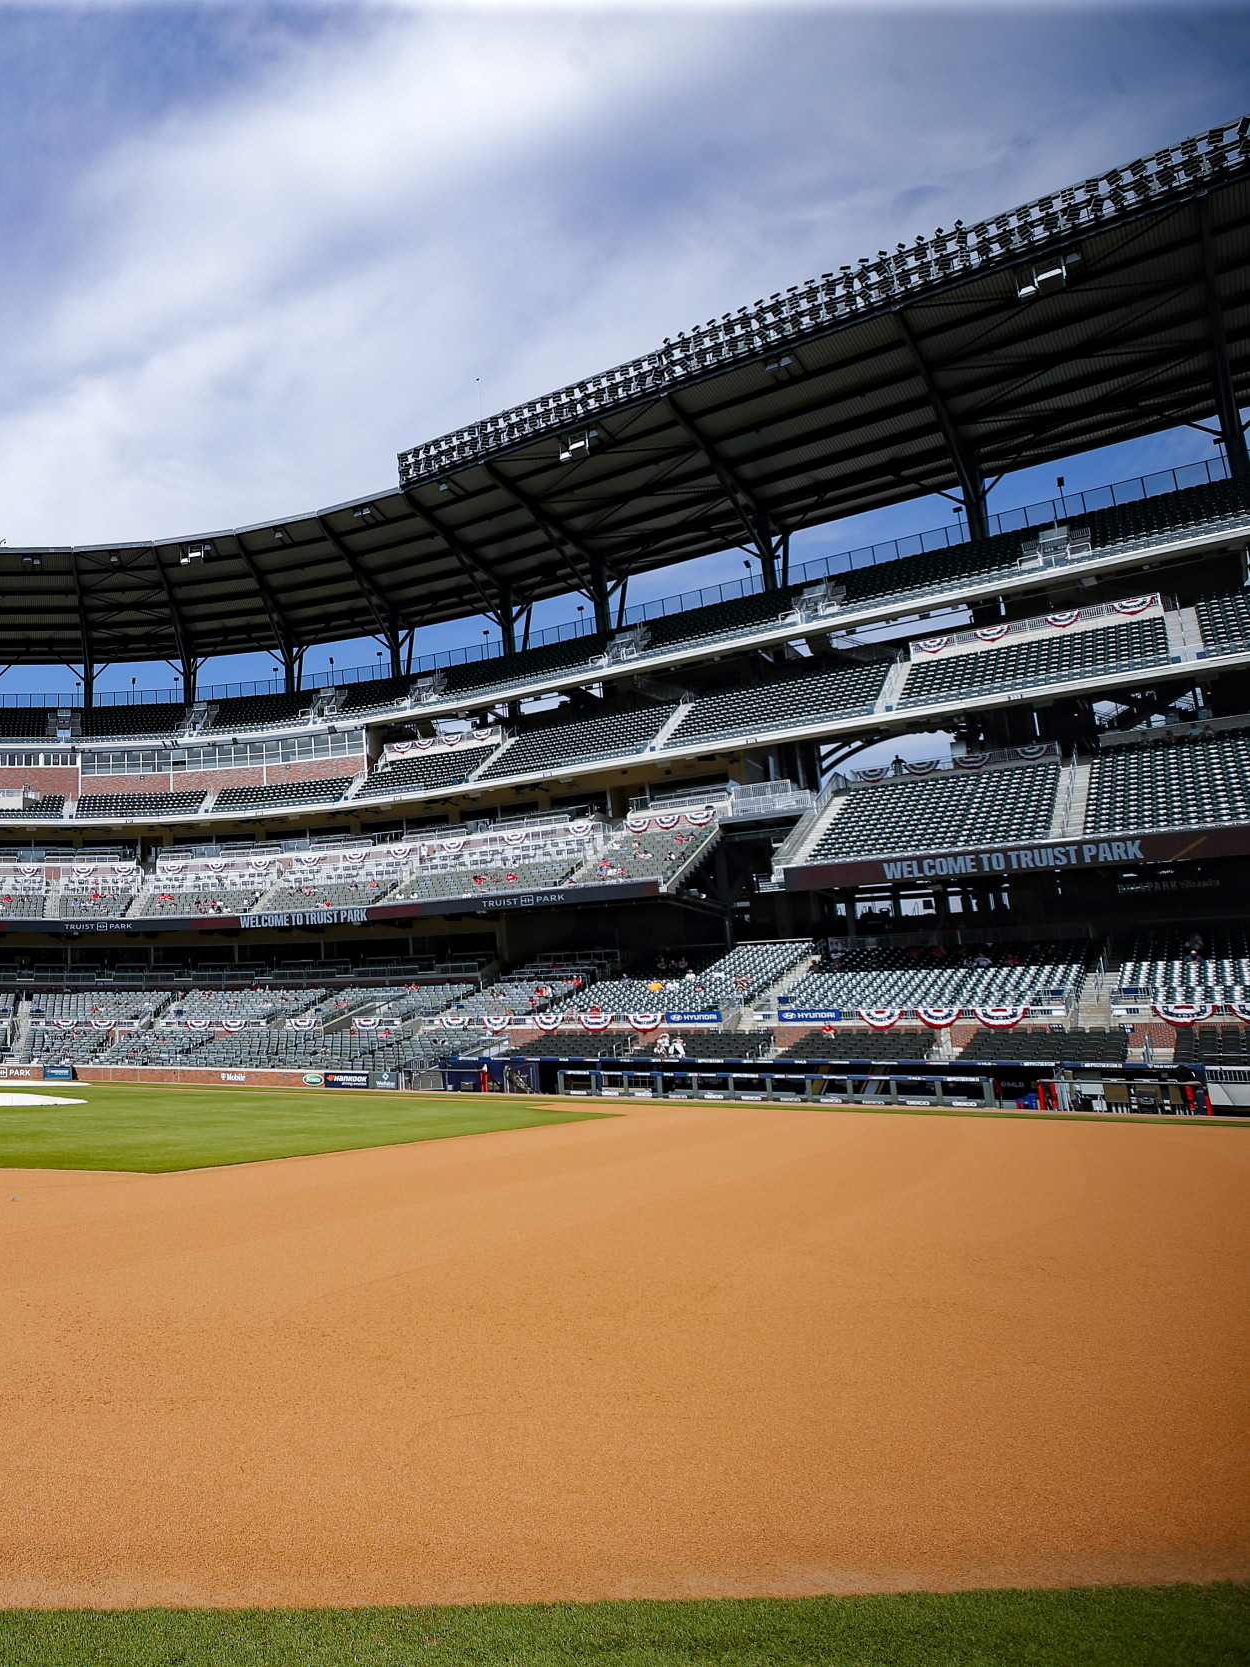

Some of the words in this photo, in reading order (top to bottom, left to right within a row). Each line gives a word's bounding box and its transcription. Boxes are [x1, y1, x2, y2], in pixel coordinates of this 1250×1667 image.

[882, 854, 978, 880] WELCOME
[979, 852, 1006, 872] TO
[1007, 845, 1078, 870] TRUIST
[1082, 840, 1144, 863] PARK
[481, 898, 518, 908] TRUIST
[536, 894, 565, 903] PARK
[240, 914, 290, 928] WELCOME
[291, 912, 304, 926] TO
[305, 910, 340, 924] TRUIST
[340, 908, 368, 922] PARK
[797, 1012, 836, 1020] HYUNDAI
